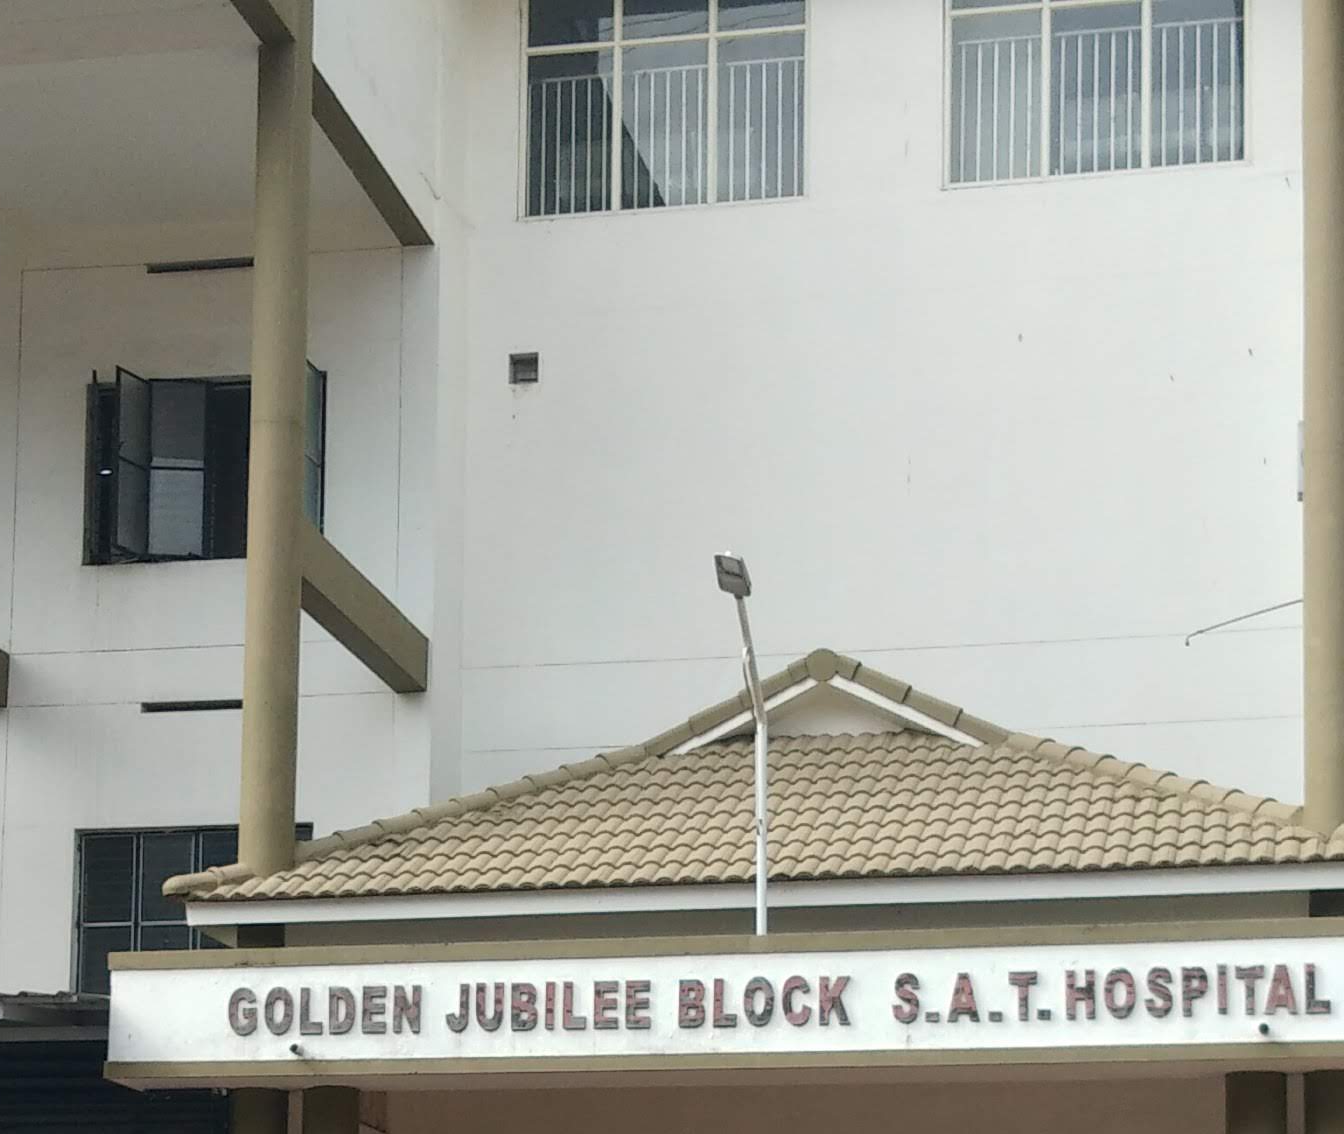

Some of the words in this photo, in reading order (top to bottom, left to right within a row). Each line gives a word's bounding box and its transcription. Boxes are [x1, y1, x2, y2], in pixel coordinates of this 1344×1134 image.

[228, 984, 423, 1036] GOLDEN
[446, 979, 653, 1033] JUBILEE
[678, 975, 852, 1029] BLOCK
[1065, 963, 1333, 1020] HOSPITAL
